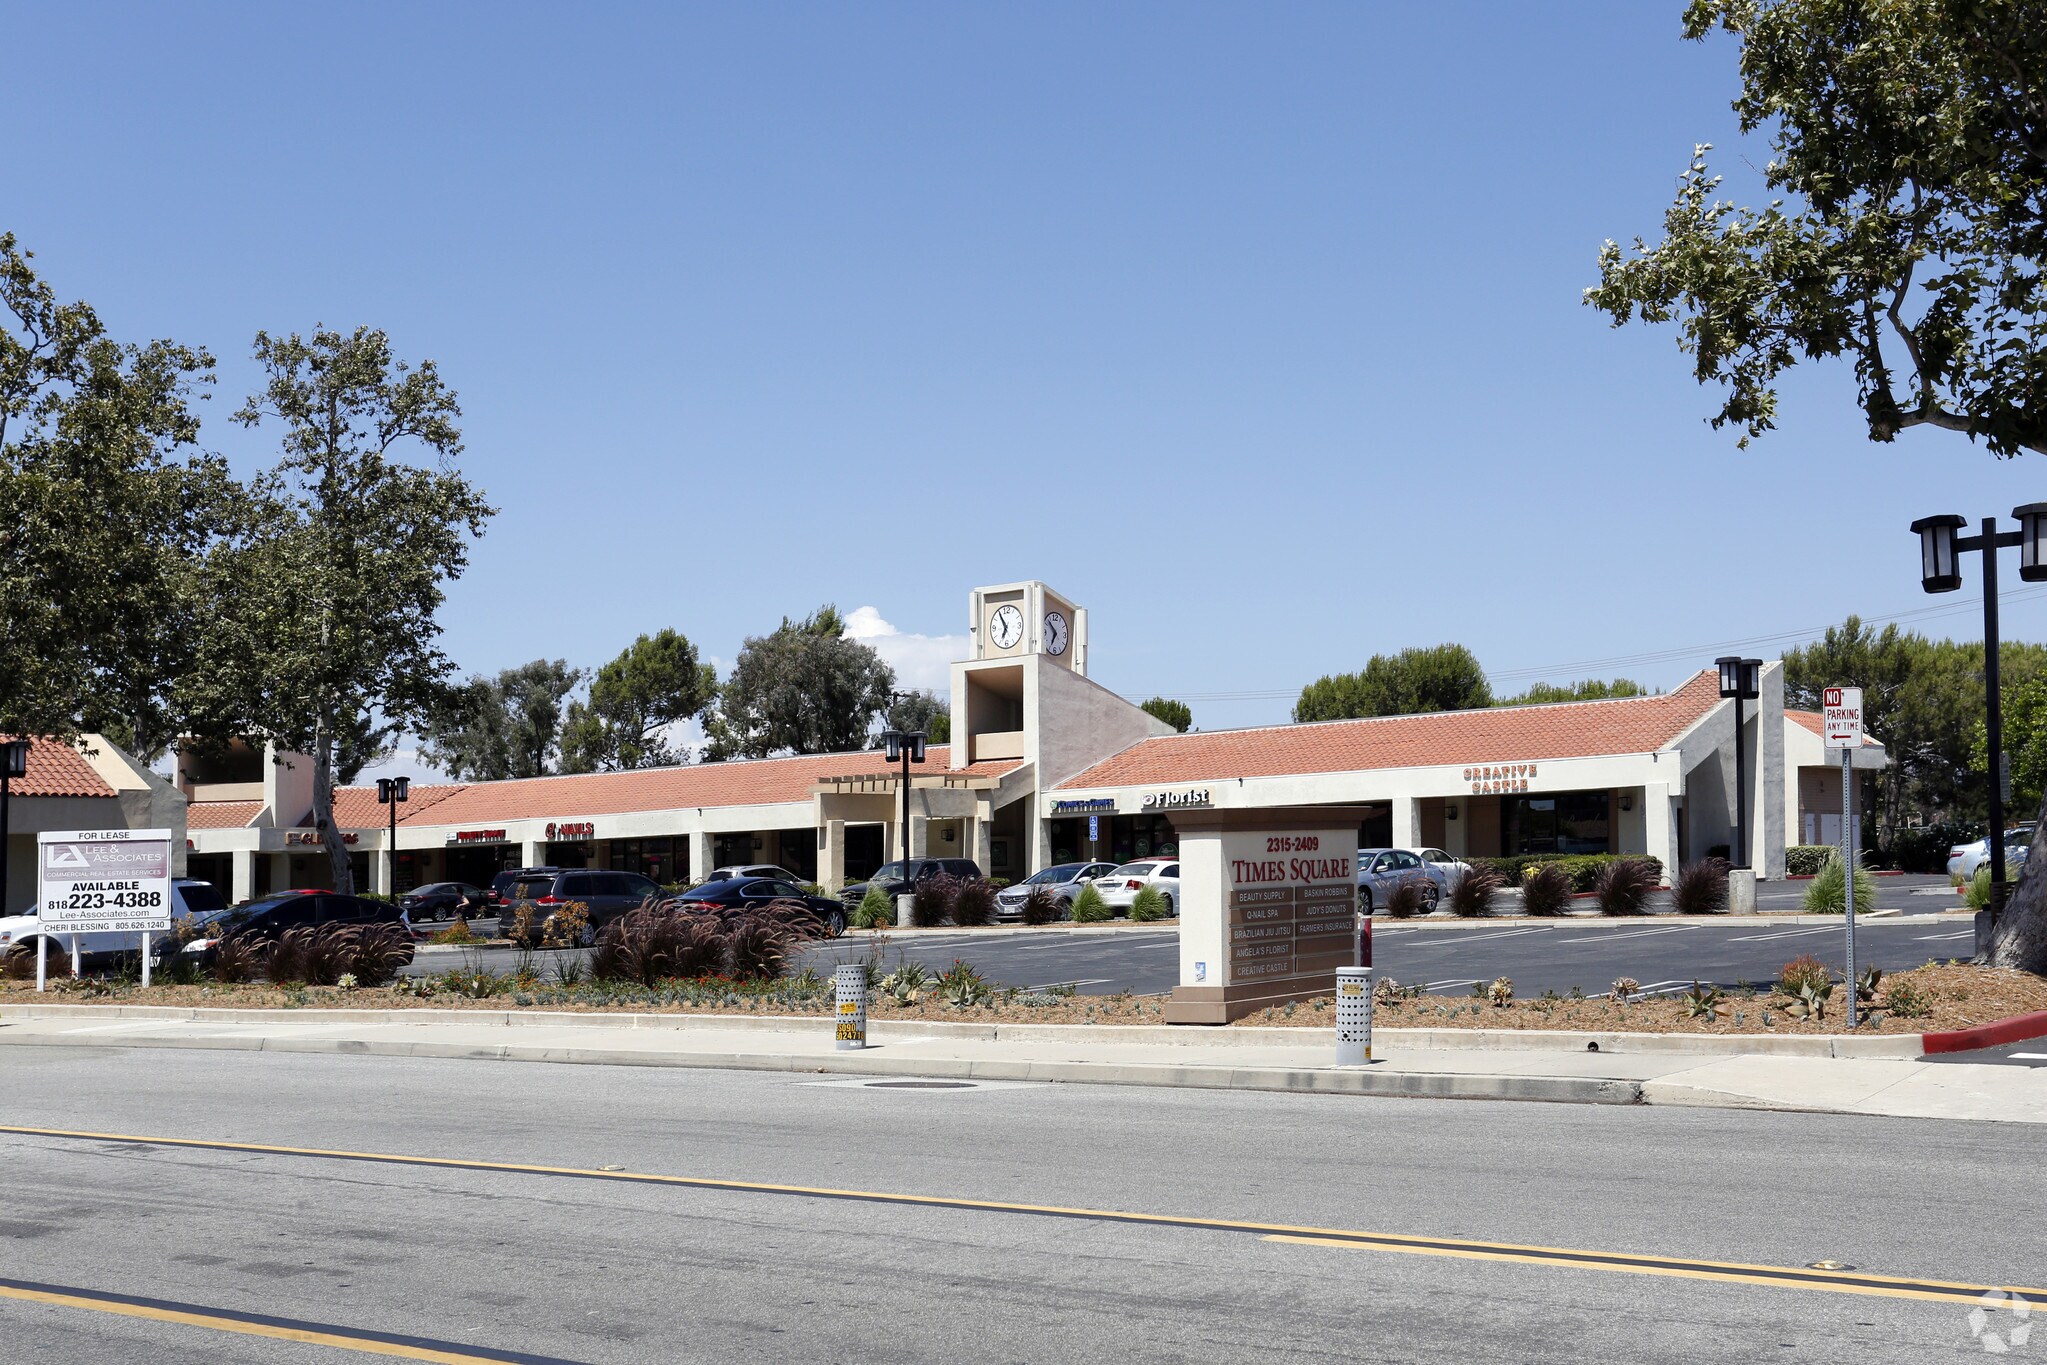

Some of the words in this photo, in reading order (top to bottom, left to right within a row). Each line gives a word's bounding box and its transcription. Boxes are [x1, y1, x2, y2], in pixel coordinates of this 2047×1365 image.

[1052, 614, 1059, 622] 12
[1052, 646, 1057, 654] 6
[1826, 690, 1840, 704] NO
[1827, 709, 1859, 720] PARKING
[1827, 722, 1840, 730] ANY
[1843, 722, 1859, 730] TIME
[1463, 764, 1537, 778] CREATIVE
[1472, 779, 1528, 792] CASTLE
[1156, 789, 1208, 804] Florist
[561, 822, 594, 834] NAILS
[78, 832, 98, 840] FOR
[101, 832, 130, 840] LEASE
[85, 846, 107, 854] LEE
[110, 844, 119, 854] &
[1266, 836, 1318, 852] 2315-2409
[1232, 860, 1286, 883] TIMES
[1290, 858, 1350, 884] SQUARE
[72, 882, 140, 892] AVAILABLE
[1304, 888, 1324, 898] BASKIN
[1324, 887, 1348, 896] ROBBINS
[48, 900, 68, 910] 818
[68, 892, 161, 909] 223-4388
[1240, 892, 1262, 902] BEAUTY
[1264, 891, 1285, 900] SUPPLY
[60, 910, 150, 919] Lee-Associates.com
[1246, 911, 1266, 920] Q-NAIL
[1268, 910, 1278, 918] SPA
[1306, 906, 1324, 915] JUDY'S
[1326, 904, 1346, 914] DONUTS
[44, 924, 69, 932] CHERI
[70, 922, 110, 931] BLESSING
[116, 921, 164, 930] 805.626.1240
[1300, 923, 1324, 933] FARMERS
[1324, 921, 1352, 932] INSURANCE
[1234, 928, 1264, 939] BRAZILIAN
[1266, 927, 1274, 936] JIU
[1275, 926, 1290, 936] JITSU
[1236, 946, 1265, 958] ANGELA'S
[1266, 944, 1288, 955] FLORIST
[1238, 965, 1265, 976] CREATIVE
[1266, 962, 1288, 972] CASTLE
